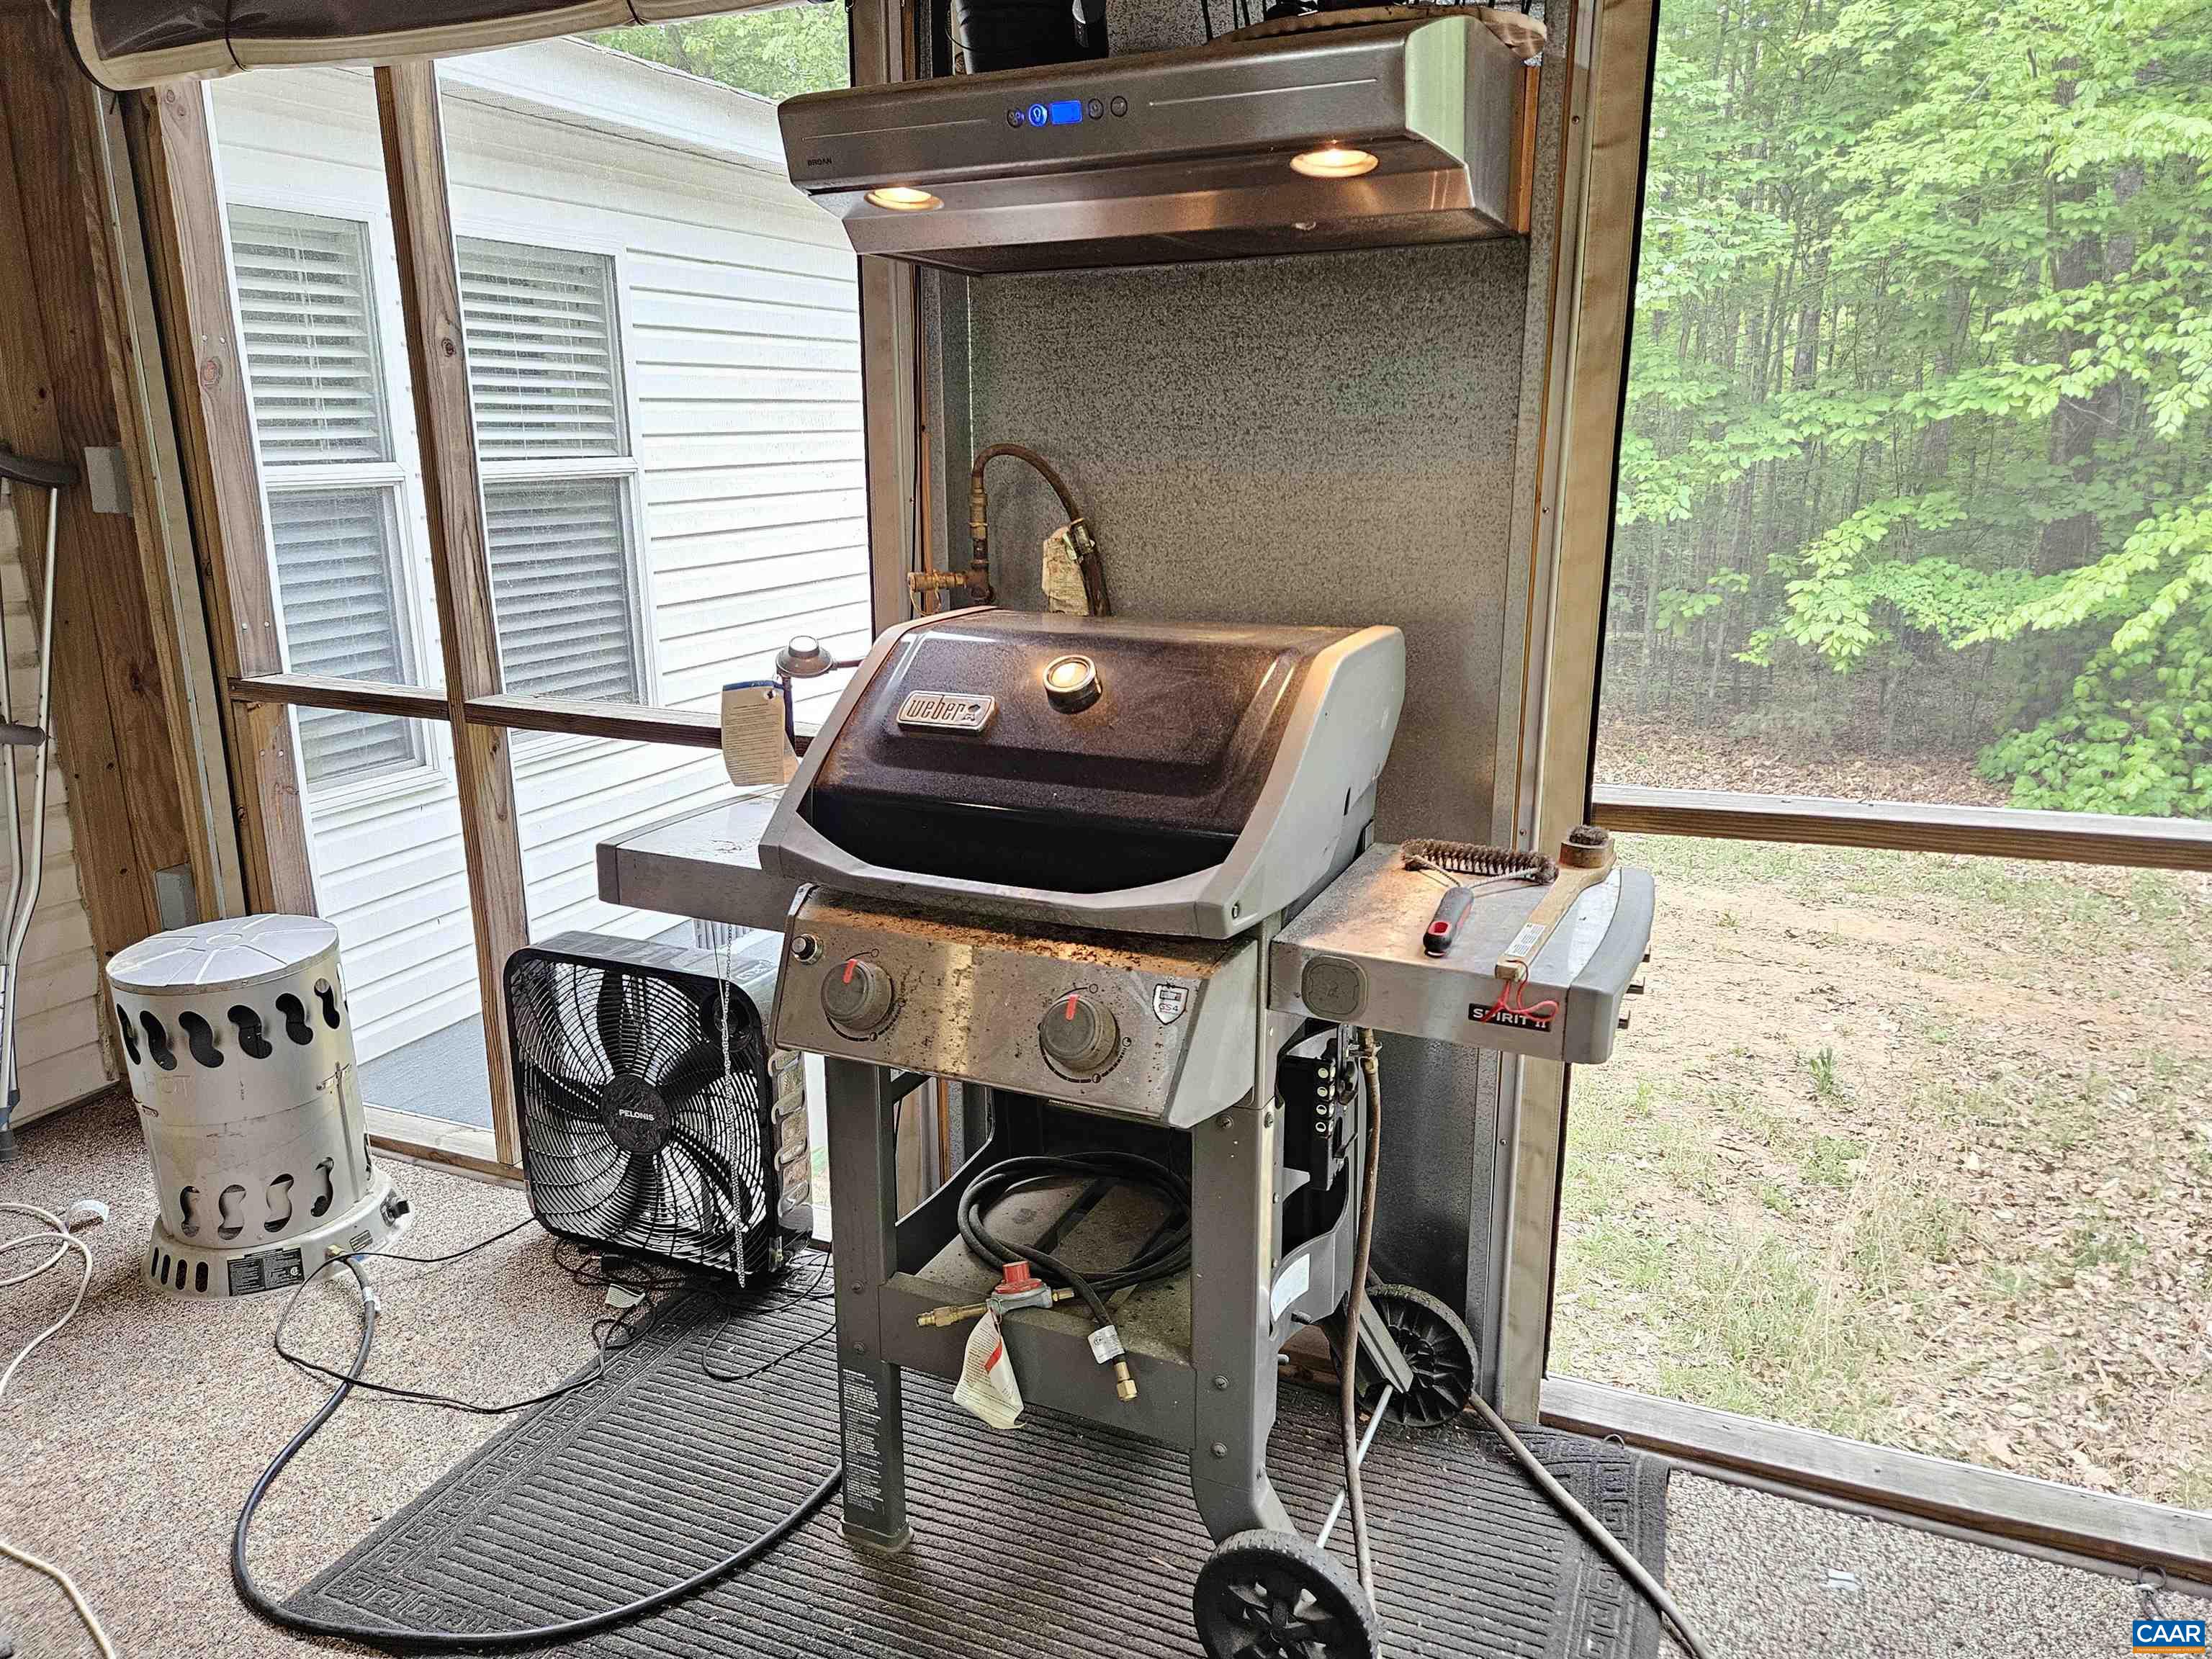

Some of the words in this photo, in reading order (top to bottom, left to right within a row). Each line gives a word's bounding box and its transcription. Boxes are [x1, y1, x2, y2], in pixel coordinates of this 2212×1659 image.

[907, 695, 966, 721] weber
[1159, 1002, 1179, 1012] GS4
[619, 1108, 655, 1122] PELONIS
